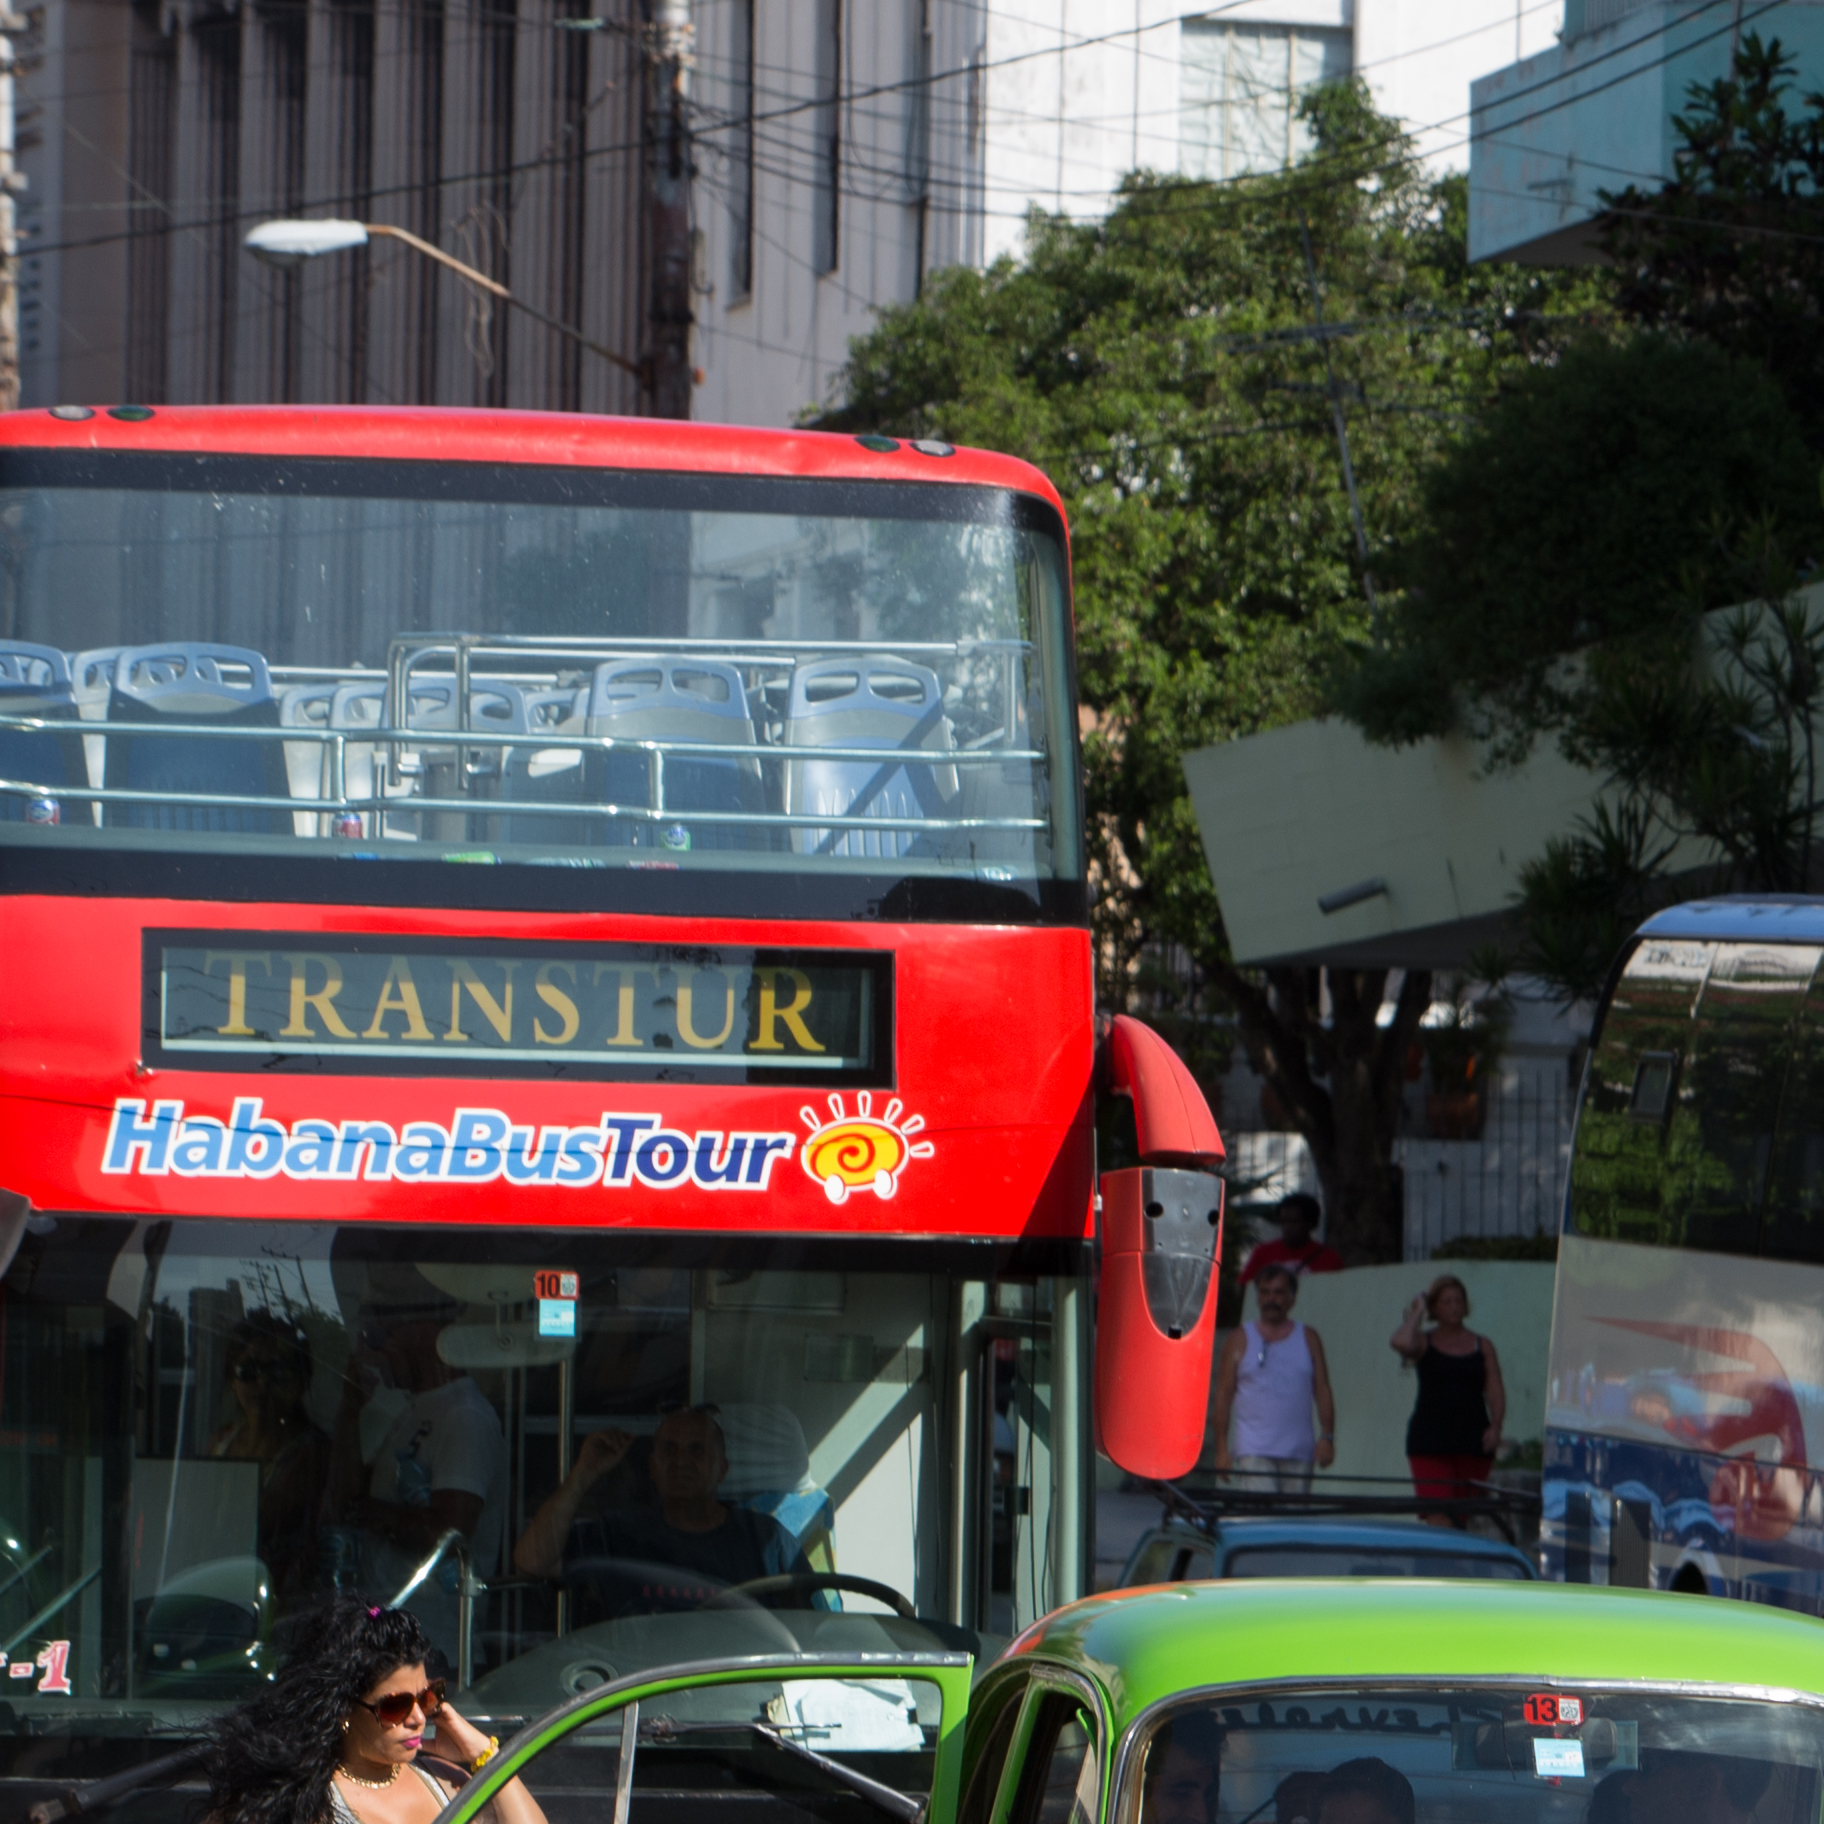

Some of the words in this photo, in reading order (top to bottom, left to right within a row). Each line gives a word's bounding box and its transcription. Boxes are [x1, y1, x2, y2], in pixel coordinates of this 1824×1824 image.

[203, 951, 826, 1054] TRANSTUR
[101, 1097, 794, 1191] HabanaBusTour
[537, 1273, 560, 1298] 10
[1525, 1697, 1558, 1722] 13
